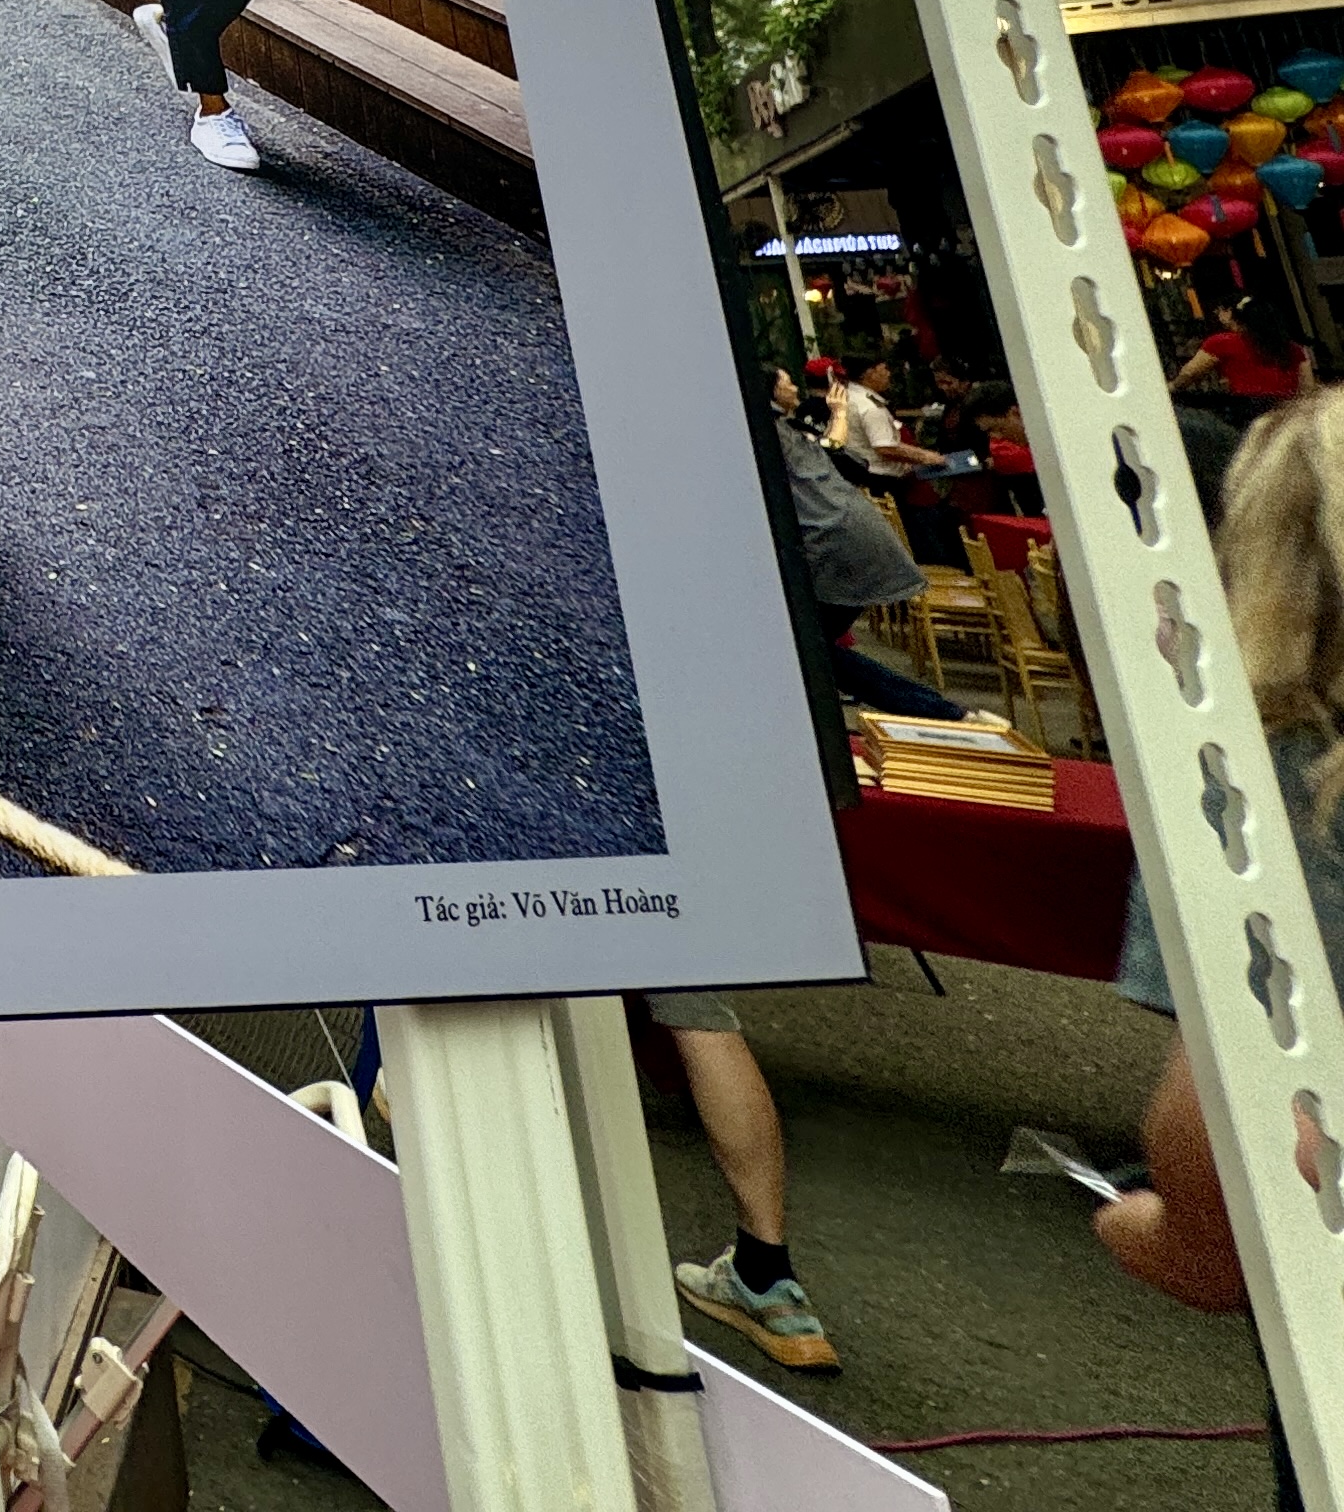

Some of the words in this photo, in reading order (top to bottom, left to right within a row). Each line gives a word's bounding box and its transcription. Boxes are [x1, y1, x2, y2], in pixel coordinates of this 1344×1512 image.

[415, 895, 461, 922] Tác
[465, 892, 508, 927] giả:
[511, 892, 546, 919] Võ
[549, 890, 599, 917] Văn
[600, 887, 680, 919] Hoàng
